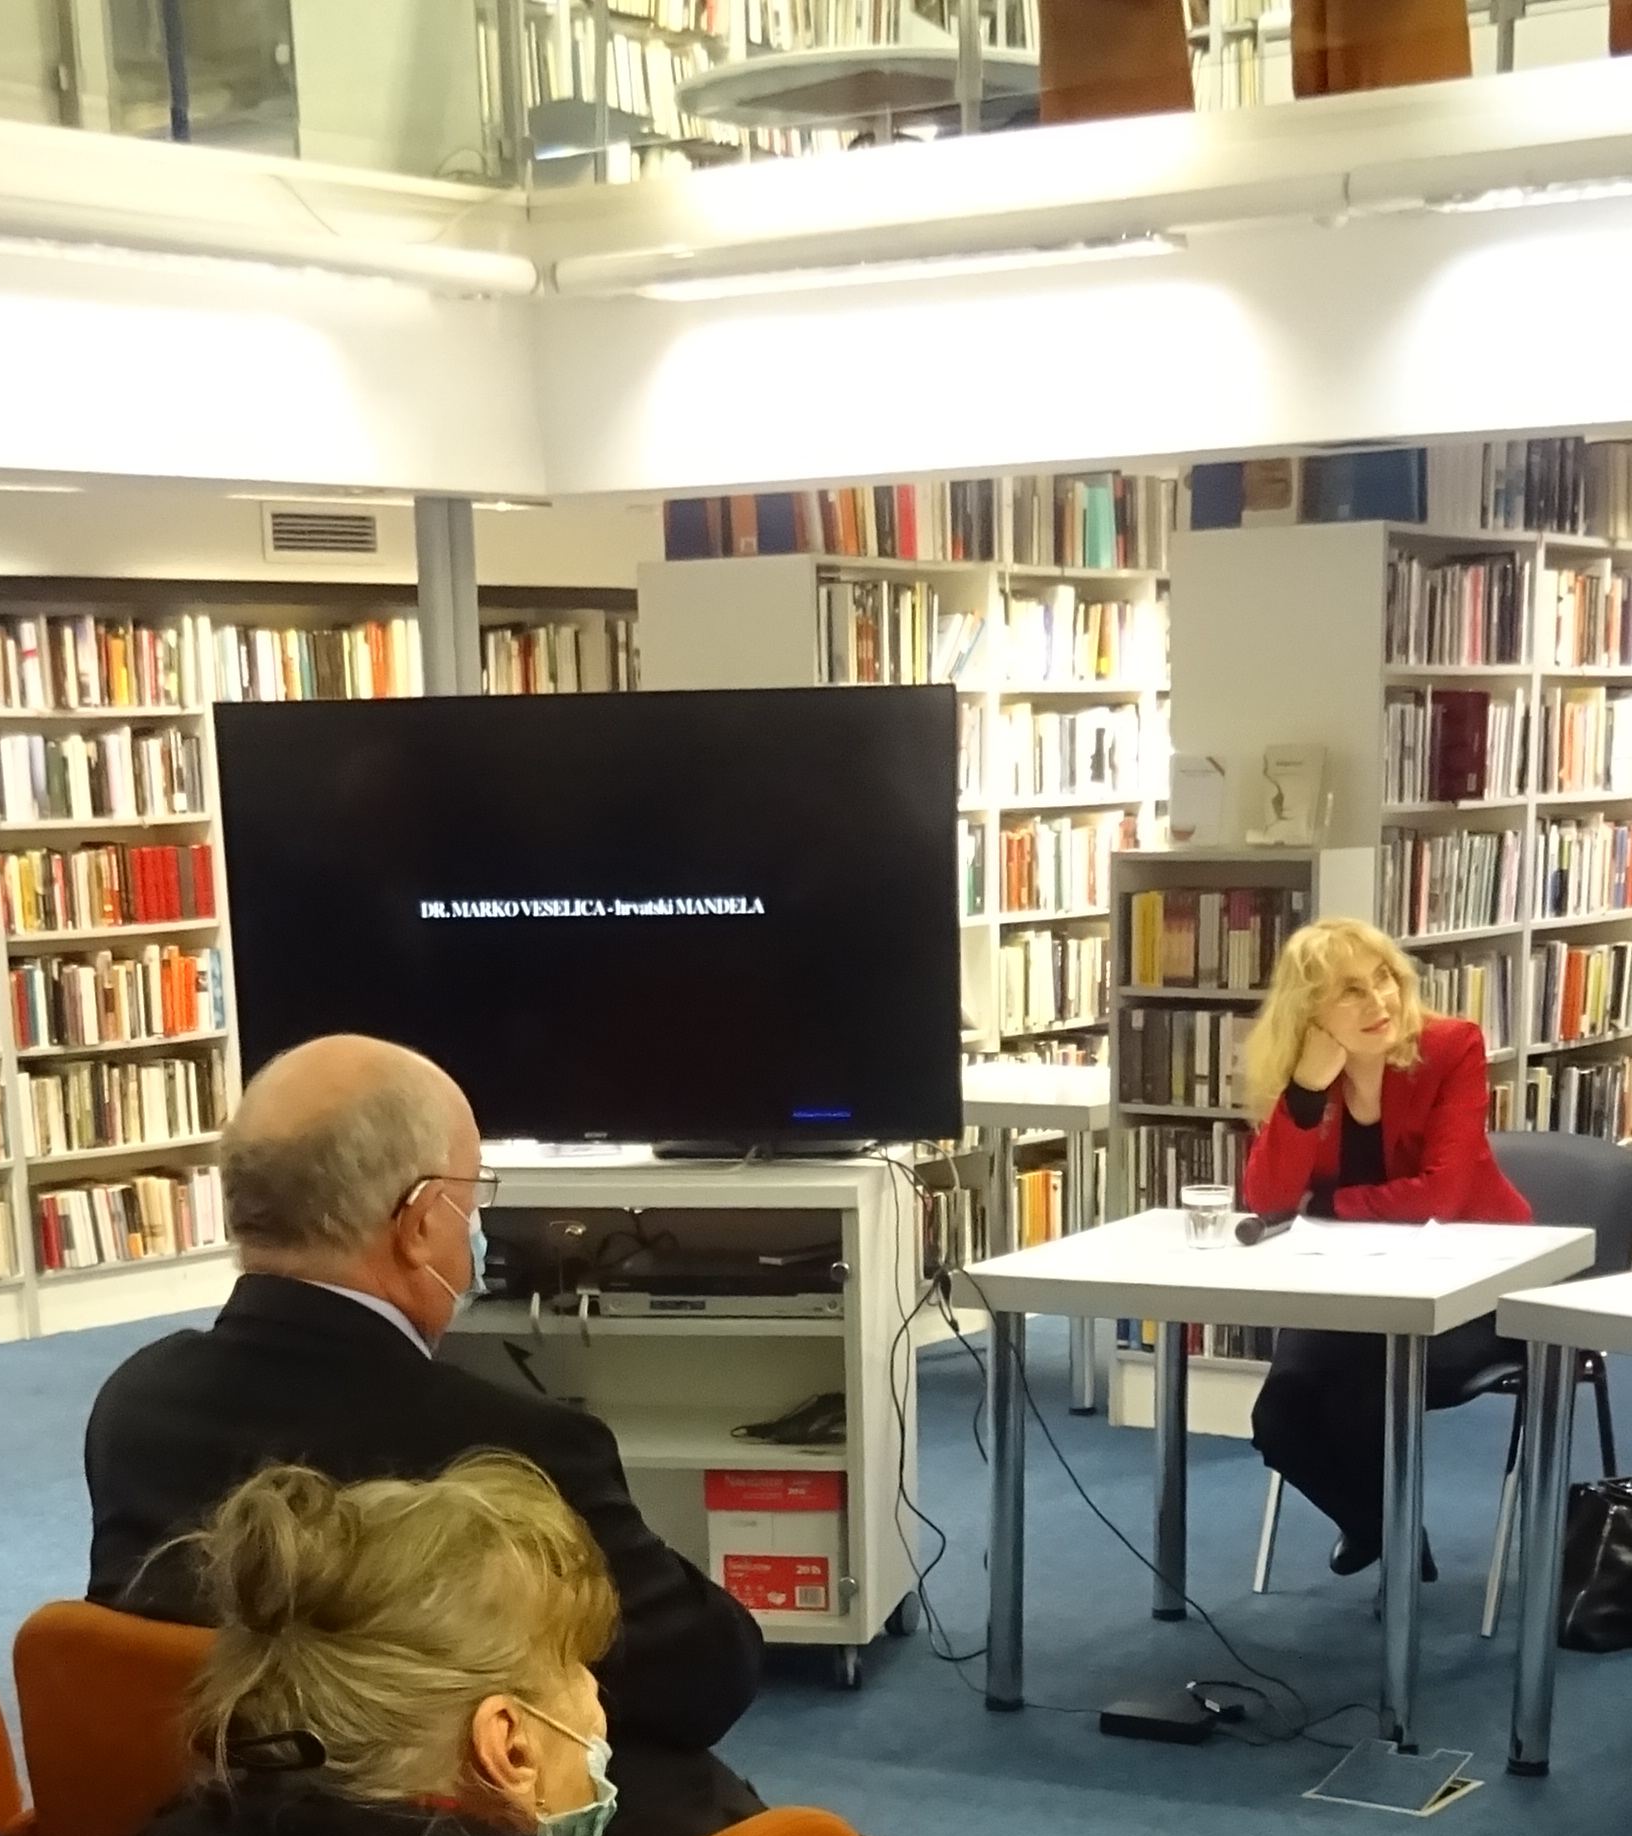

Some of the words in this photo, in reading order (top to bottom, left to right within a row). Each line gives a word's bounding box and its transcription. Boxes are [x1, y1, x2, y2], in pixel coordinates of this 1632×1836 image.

[420, 900, 451, 919] DR.
[451, 899, 519, 919] MARKO
[519, 898, 606, 917] VESELICA
[614, 897, 674, 916] hrvatski
[675, 896, 765, 915] MANDELA
